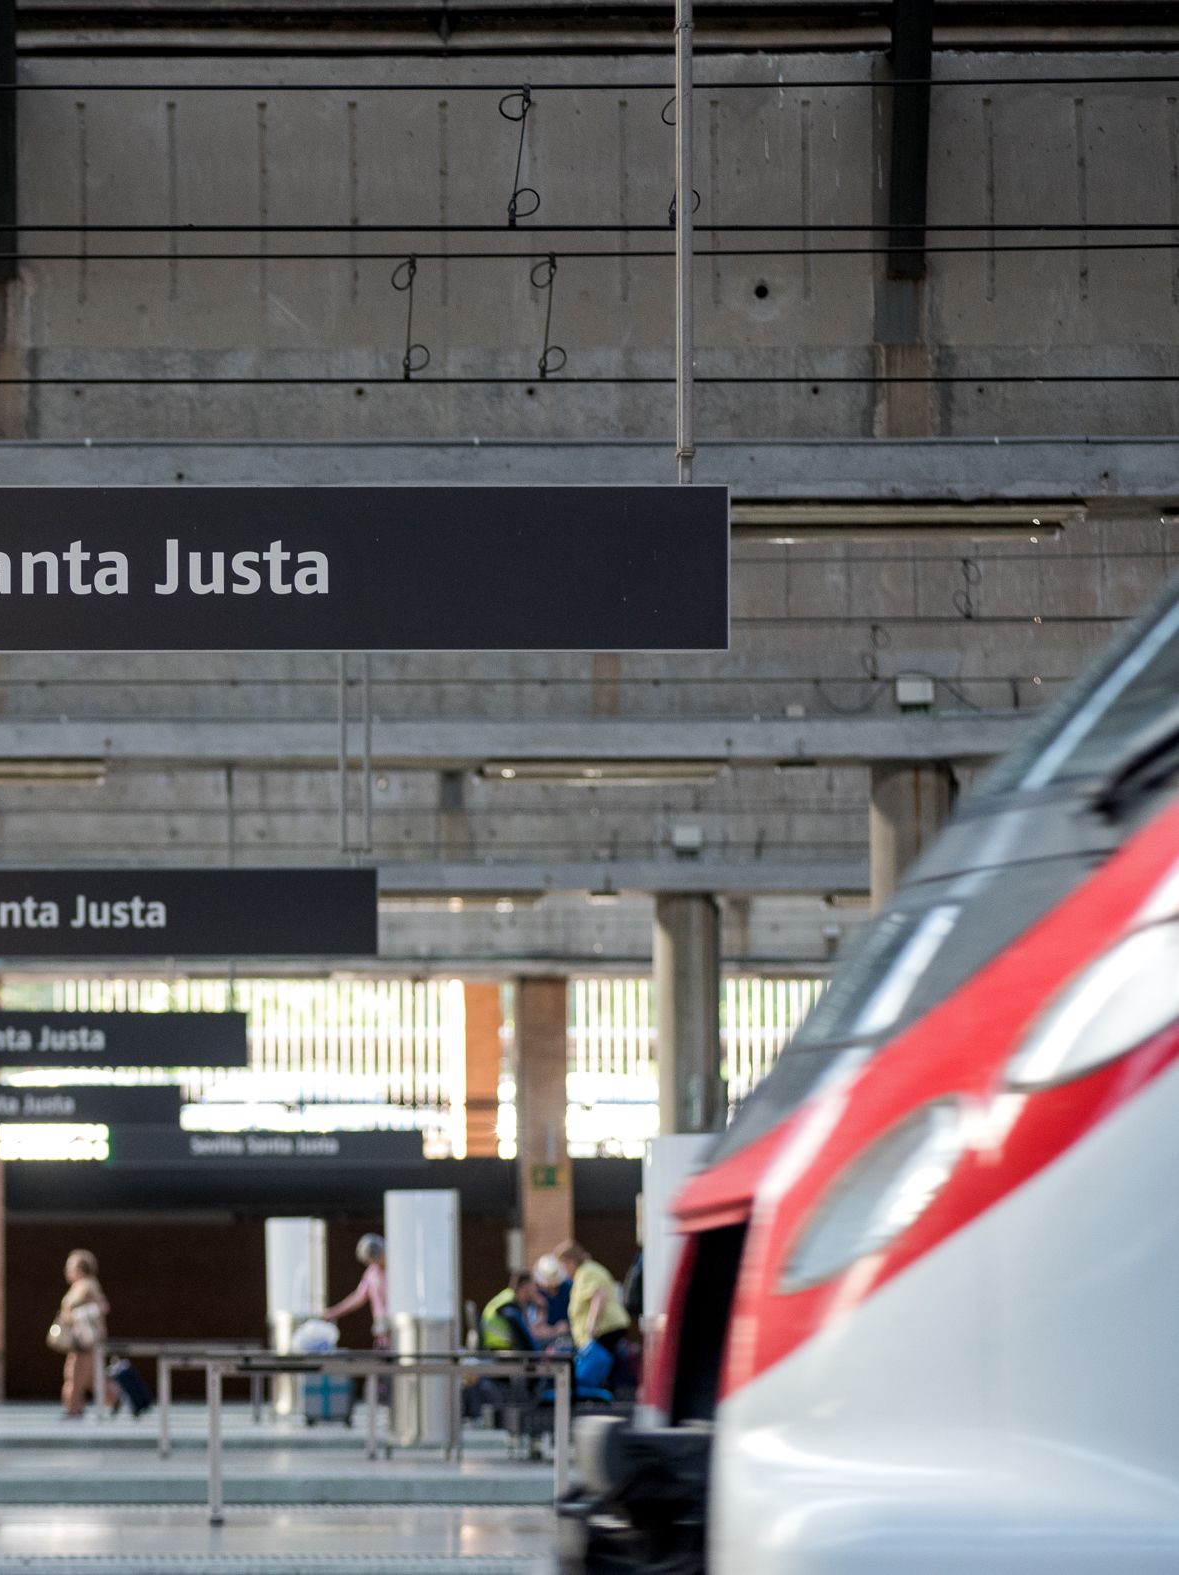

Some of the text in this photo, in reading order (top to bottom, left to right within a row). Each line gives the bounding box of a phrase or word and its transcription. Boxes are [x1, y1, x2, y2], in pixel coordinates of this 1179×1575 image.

[154, 538, 329, 595] Justa
[70, 895, 166, 929] Justa
[38, 1026, 106, 1051] Justa
[23, 1095, 76, 1116] Justa
